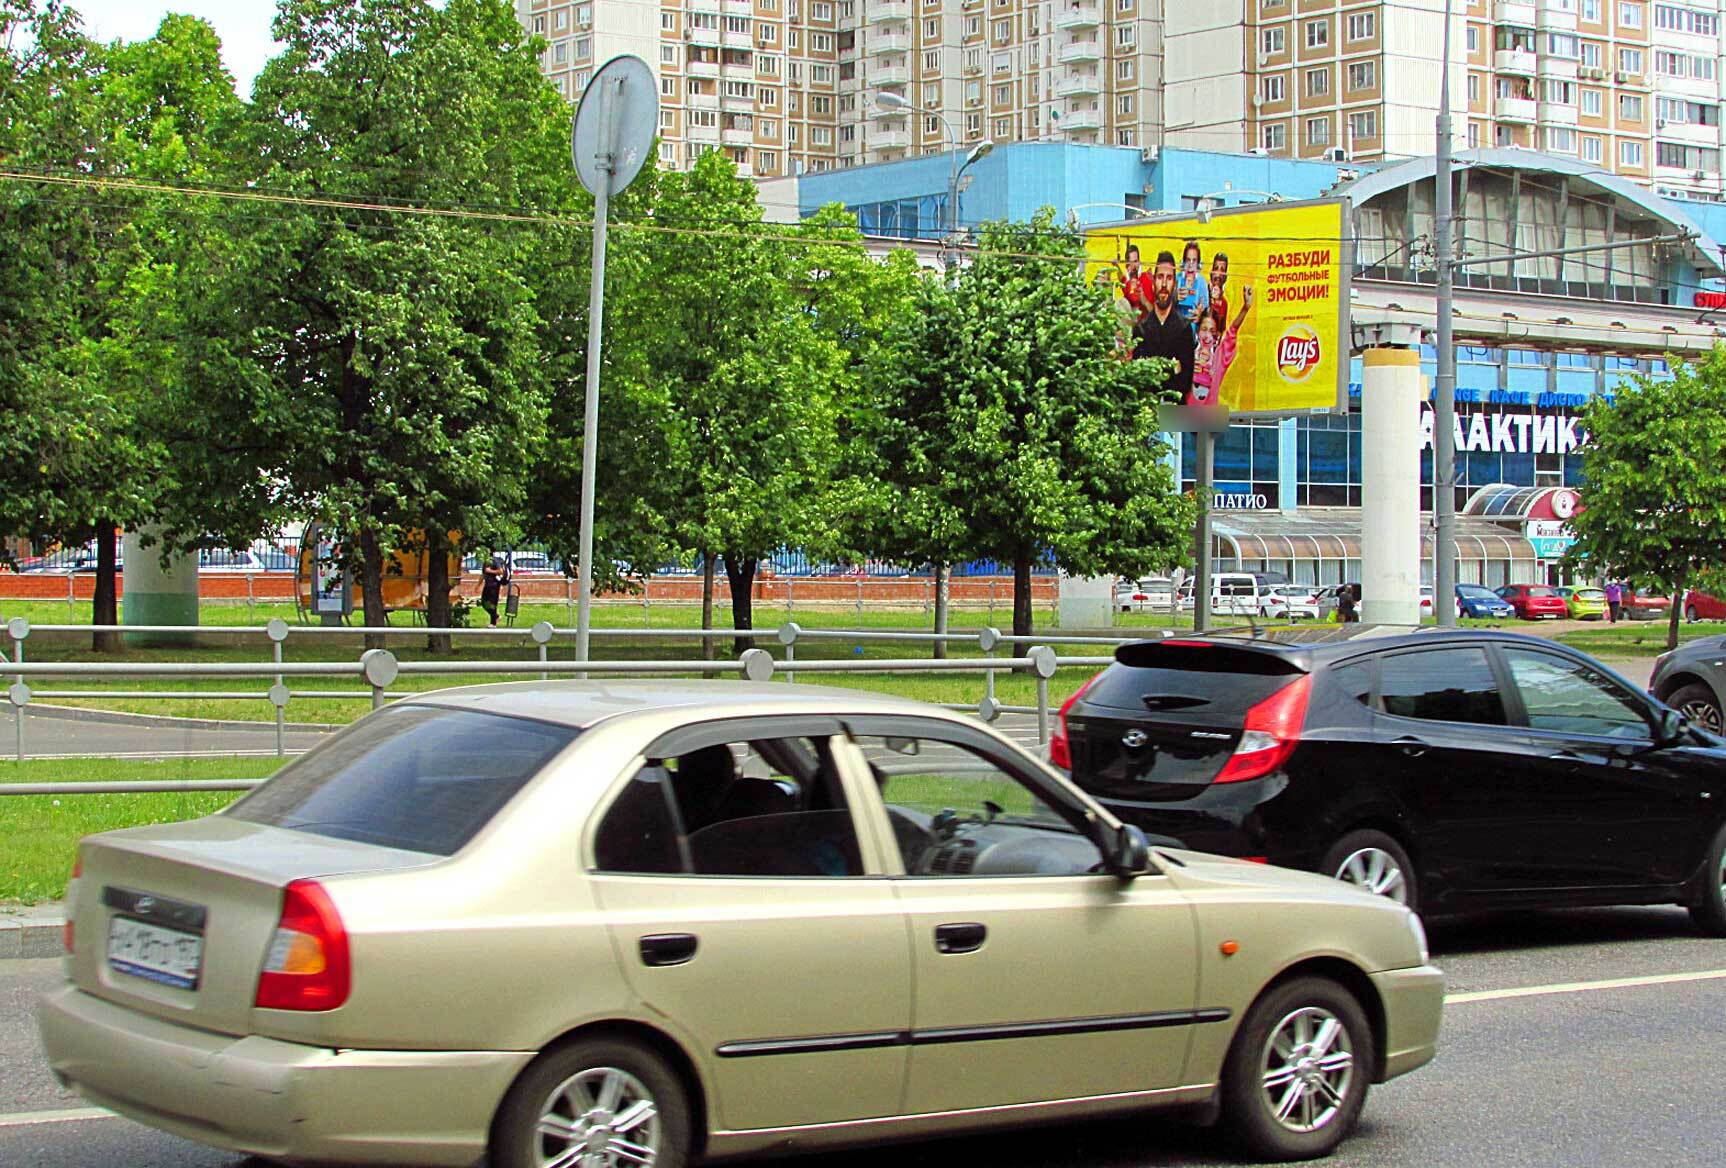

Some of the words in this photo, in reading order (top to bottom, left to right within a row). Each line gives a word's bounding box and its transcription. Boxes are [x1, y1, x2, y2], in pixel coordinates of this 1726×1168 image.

[1268, 250, 1330, 269] РАЗБУДИ
[1267, 270, 1329, 284] ФУТБОЛЬНЫЕ
[1267, 285, 1329, 303] ЭМОЦИИ!
[1490, 389, 1530, 404] КАФЕ
[1213, 493, 1268, 509] ПАТИО
